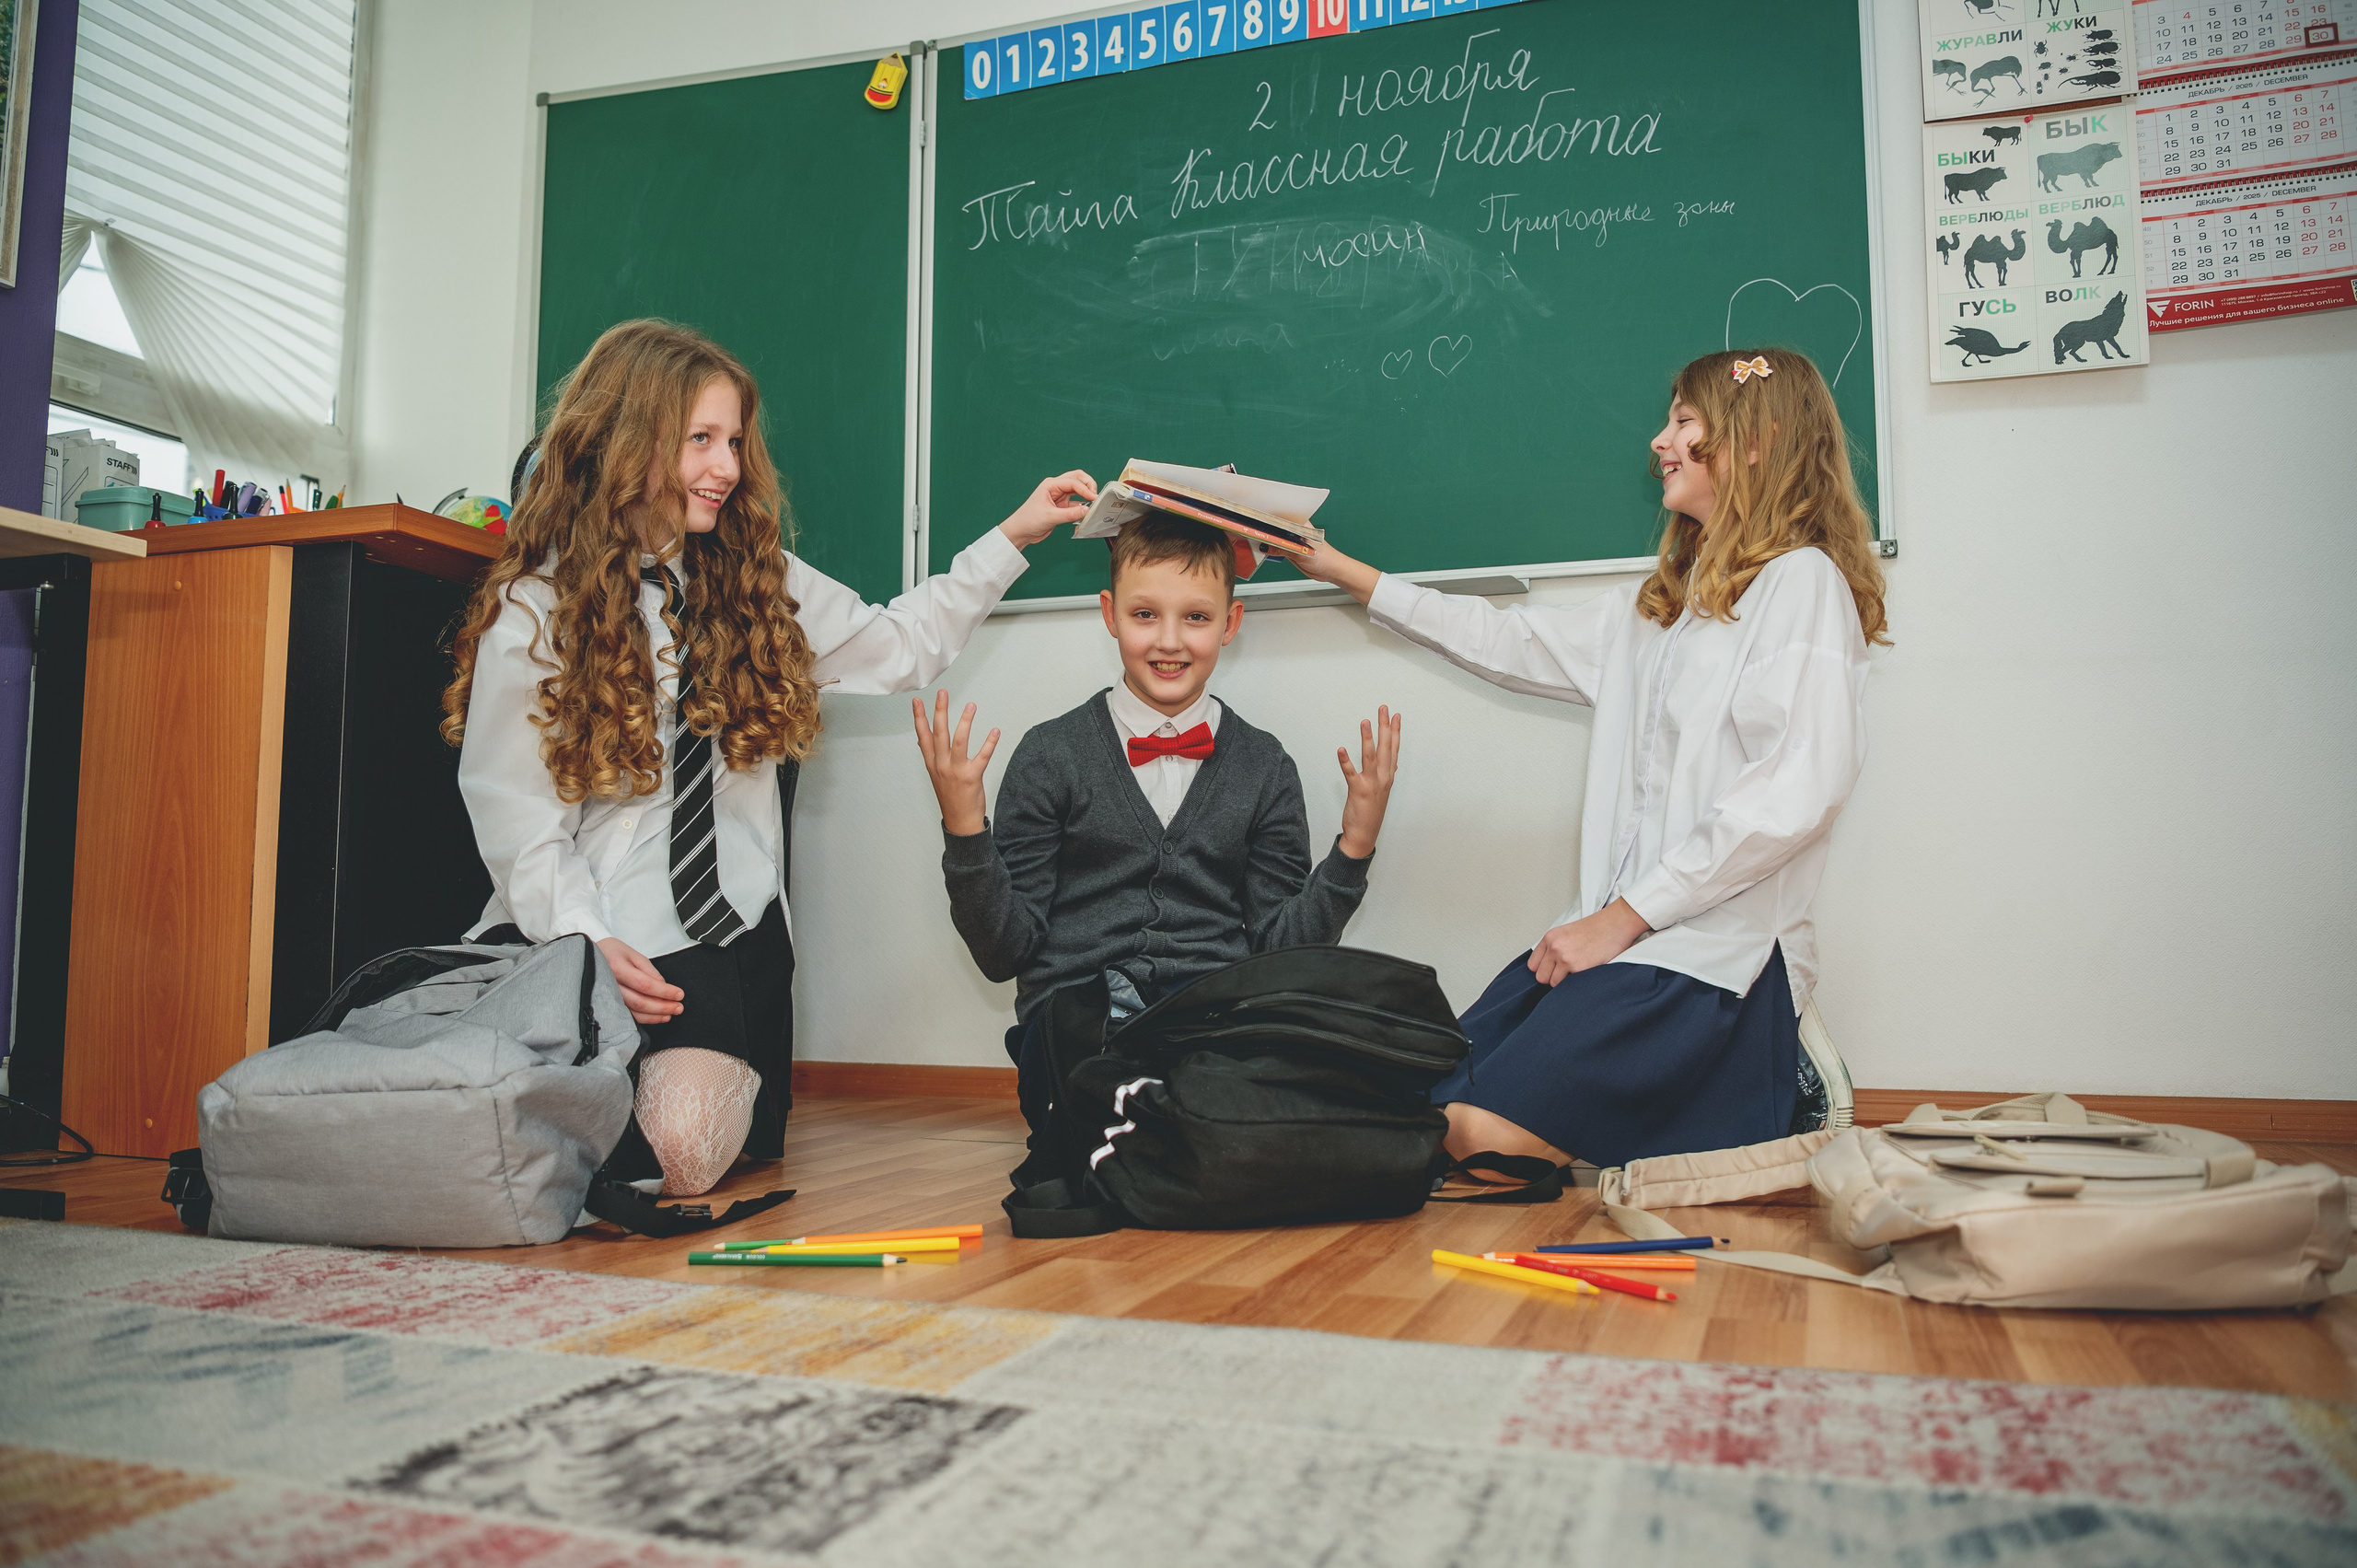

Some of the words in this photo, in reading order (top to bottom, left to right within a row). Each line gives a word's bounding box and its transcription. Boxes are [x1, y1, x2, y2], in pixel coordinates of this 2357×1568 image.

[2235, 5, 2242, 13] 6
[2260, 0, 2268, 8] 7
[2046, 16, 2097, 33] ЖУКИ
[2156, 29, 2170, 38] 10
[2181, 25, 2194, 33] 11
[2207, 21, 2221, 29] 12
[2233, 17, 2247, 26] 13
[2258, 13, 2273, 22] 14
[2284, 8, 2300, 17] 15
[2311, 5, 2326, 13] 16
[972, 51, 992, 89] 0
[1006, 44, 1020, 83] 1
[1038, 38, 1056, 78] 2
[1071, 32, 1089, 72] 3
[1104, 26, 1124, 64] 4
[1140, 18, 1156, 60] 5
[1173, 12, 1193, 52] 6
[1208, 6, 1227, 47] 7
[1243, 0, 1263, 41] 8
[1279, 0, 1299, 34] 9
[1314, 0, 1344, 28] 10
[1936, 29, 2023, 52] ЖУРАВЛИ
[2157, 41, 2170, 51] 17
[2182, 38, 2197, 46] 18
[2208, 34, 2222, 42] 19
[2232, 30, 2248, 40] 20
[2258, 27, 2272, 36] 21
[2284, 21, 2300, 31] 22
[2157, 55, 2172, 64] 24
[2182, 51, 2198, 60] 25
[2208, 47, 2223, 56] 26
[2234, 44, 2248, 53] 27
[2259, 40, 2275, 49] 28
[2286, 35, 2302, 44] 29
[2313, 31, 2328, 40] 30
[1248, 82, 1278, 131] 2
[1339, 29, 1540, 126] ноября
[2188, 87, 2224, 99] ДЕКАБРЬ
[2235, 82, 2254, 90] 2025
[2264, 74, 2308, 86] DECEMBER
[2190, 110, 2198, 118] 2
[2216, 106, 2223, 114] 3
[2269, 98, 2276, 106] 5
[2294, 94, 2303, 102] 6
[2321, 90, 2328, 99] 7
[2214, 119, 2229, 127] 10
[2240, 115, 2253, 123] 11
[2267, 110, 2281, 120] 12
[2293, 107, 2307, 116] 13
[2319, 103, 2334, 112] 14
[2046, 114, 2107, 140] БЫК
[2165, 140, 2178, 148] 15
[2189, 136, 2204, 145] 16
[2215, 132, 2229, 141] 17
[2241, 128, 2256, 137] 18
[2268, 124, 2282, 133] 19
[2293, 121, 2309, 130] 20
[2319, 117, 2334, 126] 21
[1171, 134, 1414, 218] Классная
[1430, 88, 1662, 196] работа
[1937, 149, 1995, 167] БЫКИ
[2165, 153, 2179, 162] 22
[2189, 149, 2205, 158] 23
[2215, 145, 2231, 155] 24
[2242, 142, 2258, 151] 25
[2268, 138, 2283, 147] 26
[2294, 134, 2309, 144] 27
[2321, 130, 2337, 140] 28
[2165, 167, 2180, 175] 29
[2191, 163, 2207, 171] 30
[2217, 159, 2230, 168] 31
[2038, 194, 2125, 215] ВЕРБЛЮД
[2195, 196, 2233, 207] ДЕКАБРЬ
[2271, 185, 2316, 197] DECEMBER
[1477, 192, 1655, 255] Природные
[1939, 208, 2028, 226] ВЕРБЛЮДЫ
[2223, 215, 2231, 224] 3
[2276, 209, 2283, 217] 5
[2303, 205, 2310, 214] 6
[2329, 202, 2337, 210] 7
[2199, 232, 2206, 240] 9
[2222, 228, 2236, 238] 10
[2248, 226, 2260, 234] 11
[2274, 222, 2289, 231] 12
[2301, 219, 2316, 227] 13
[2328, 215, 2343, 224] 14
[2172, 249, 2186, 257] 15
[2197, 245, 2212, 253] 16
[2223, 242, 2237, 250] 17
[2249, 239, 2264, 248] 18
[2275, 236, 2290, 244] 19
[2301, 232, 2317, 241] 20
[2328, 228, 2342, 238] 21
[2172, 261, 2187, 271] 22
[2198, 259, 2212, 267] 23
[2223, 256, 2239, 264] 24
[2249, 252, 2265, 261] 25
[2276, 250, 2292, 259] 26
[2303, 246, 2318, 255] 27
[2329, 242, 2346, 251] 28
[2173, 275, 2188, 284] 29
[2199, 272, 2214, 281] 30
[2224, 269, 2238, 278] 31
[2045, 285, 2101, 304] ВОЛК
[2174, 299, 2214, 312] FORIN
[1959, 298, 2016, 317] ГУСЬ
[2149, 318, 2183, 328] Лучшие
[2184, 312, 2223, 324] решения
[2225, 310, 2241, 319] для
[2243, 307, 2275, 317] вашего
[2277, 300, 2314, 311] бизнеса
[2316, 296, 2344, 306] online
[107, 458, 131, 471] STAFF
